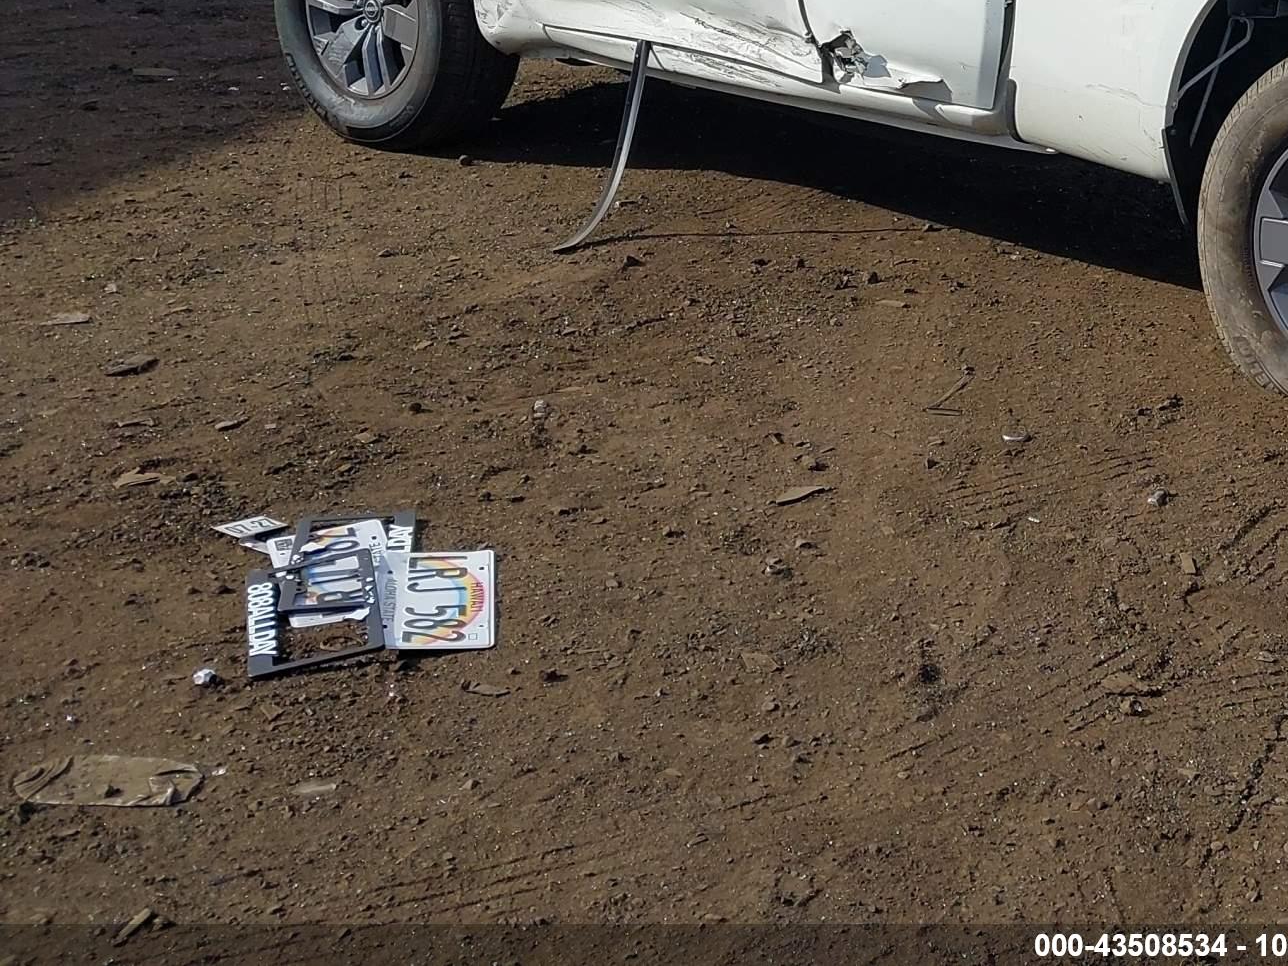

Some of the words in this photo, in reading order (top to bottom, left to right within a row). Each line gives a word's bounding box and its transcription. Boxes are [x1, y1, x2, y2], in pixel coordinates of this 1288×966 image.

[383, 578, 398, 600] ALOHA
[407, 556, 468, 592] LRJ
[248, 583, 277, 657] 808ALLDAY
[383, 602, 397, 622] STATE
[402, 604, 467, 643] 582
